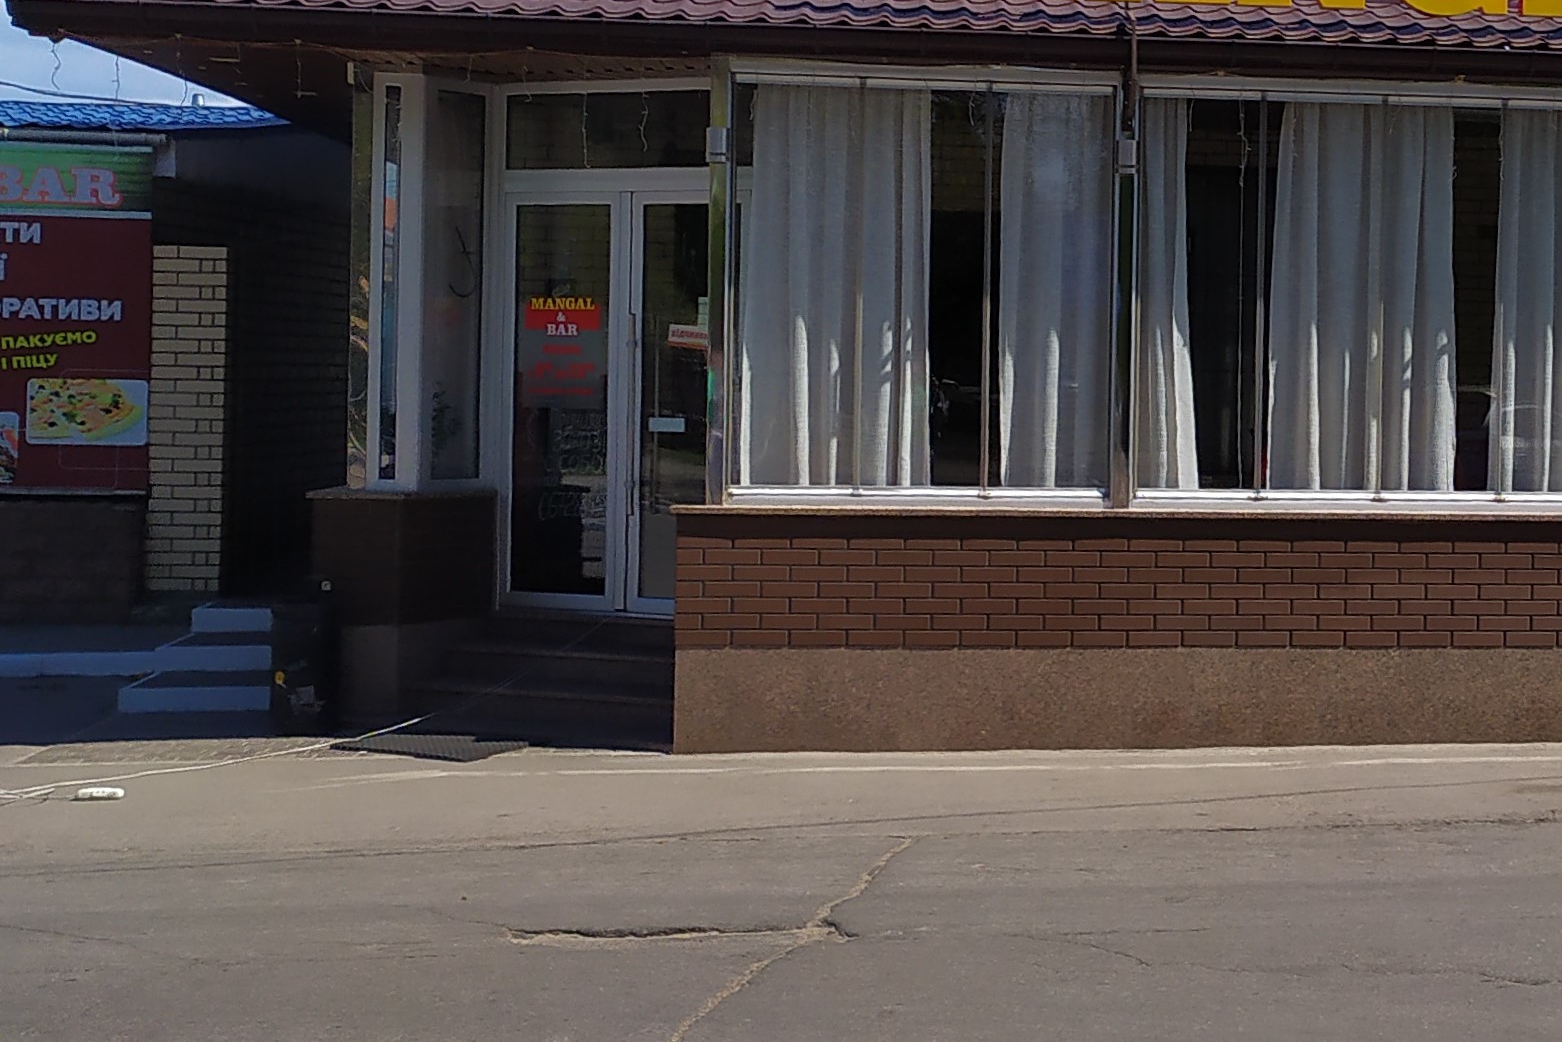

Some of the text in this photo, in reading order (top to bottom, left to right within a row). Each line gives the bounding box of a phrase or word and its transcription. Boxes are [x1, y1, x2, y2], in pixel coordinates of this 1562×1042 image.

[0, 297, 122, 322] РАТИВИ
[530, 297, 596, 311] MANGAL
[556, 311, 567, 323] &
[546, 323, 579, 336] BAR
[11, 353, 58, 369] ПІЦУ
